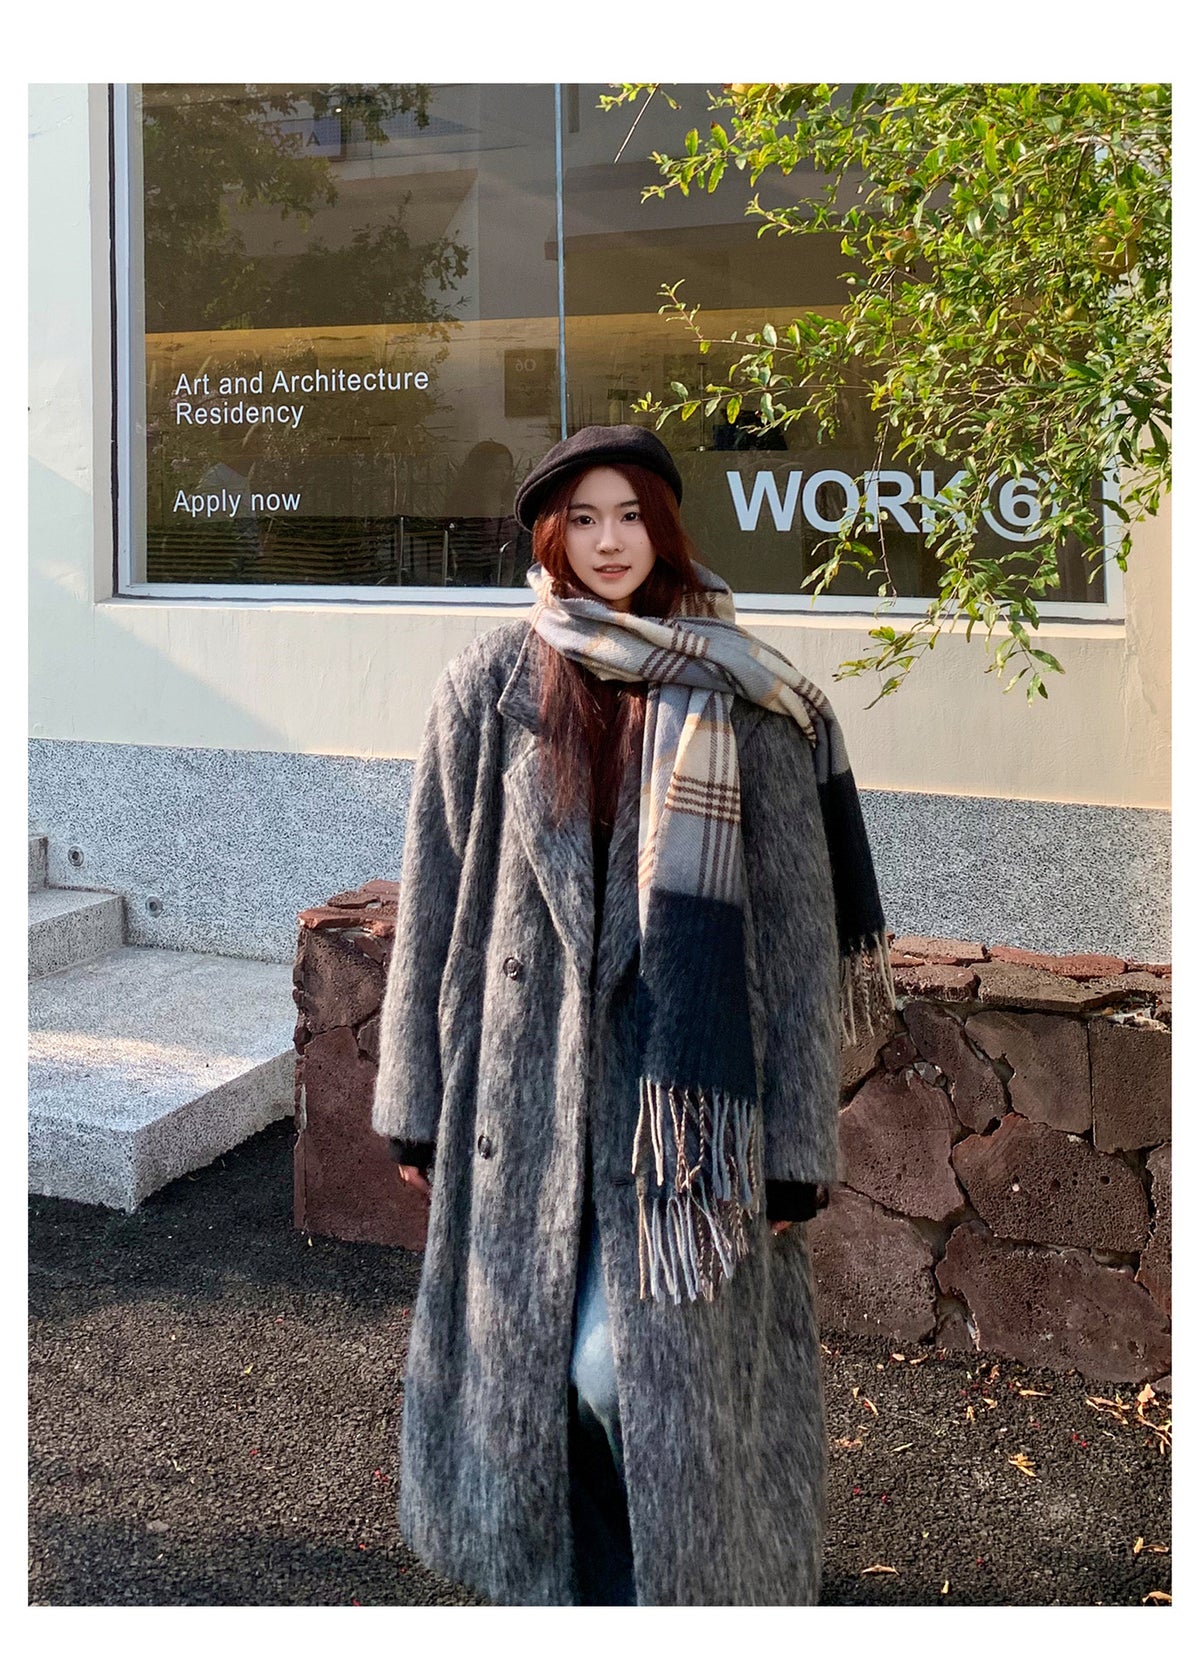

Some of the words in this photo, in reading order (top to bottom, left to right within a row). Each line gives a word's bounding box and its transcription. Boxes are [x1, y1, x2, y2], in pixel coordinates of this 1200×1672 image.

[174, 373, 210, 396] Art
[219, 370, 263, 395] and
[271, 367, 429, 394] Architecture
[175, 401, 304, 429] Residency
[173, 488, 241, 518] Apply
[251, 493, 301, 512] now
[726, 470, 979, 534] WORK
